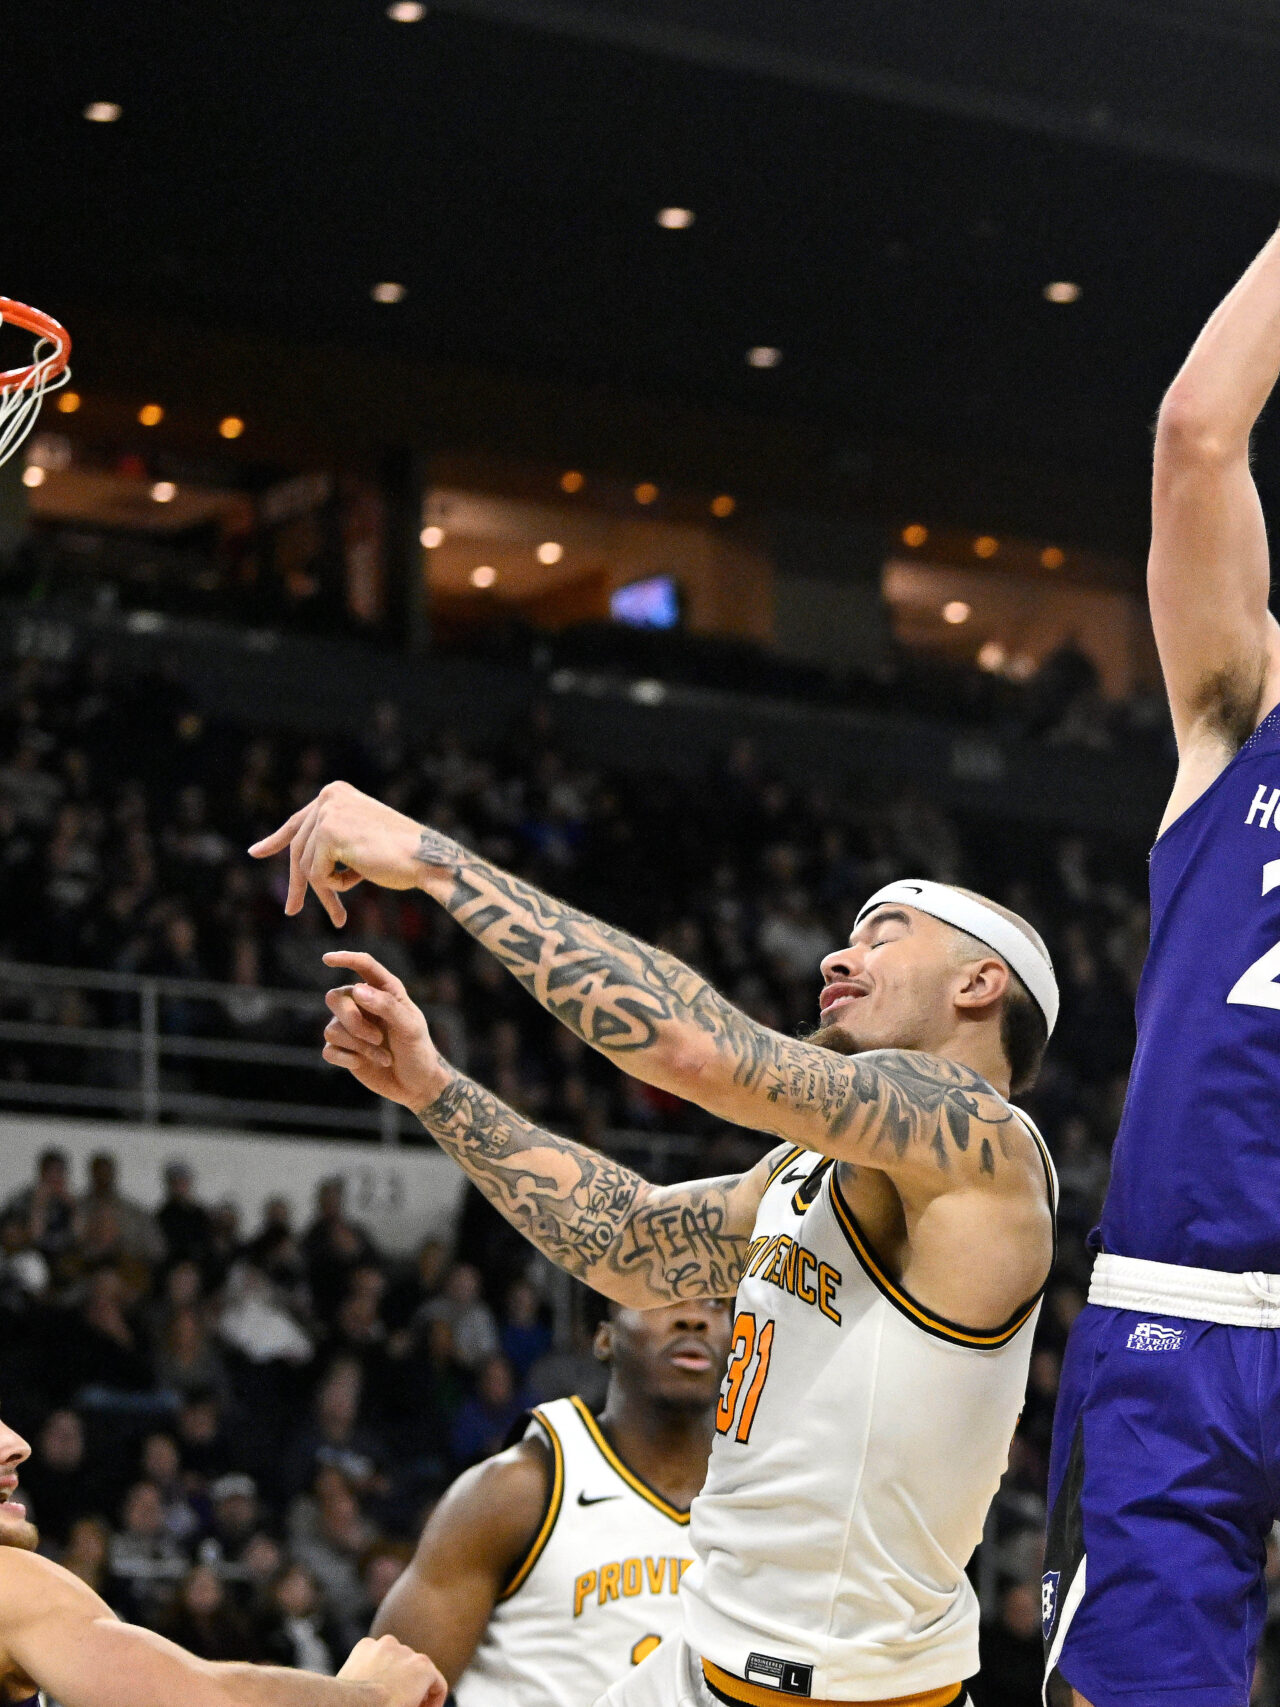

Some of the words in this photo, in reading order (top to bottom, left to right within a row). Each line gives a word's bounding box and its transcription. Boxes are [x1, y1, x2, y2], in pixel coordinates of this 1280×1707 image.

[1126, 1340, 1181, 1351] LEAGUE
[1128, 1333, 1184, 1346] PATRIOT
[716, 1312, 776, 1444] 31
[791, 1671, 799, 1687] L
